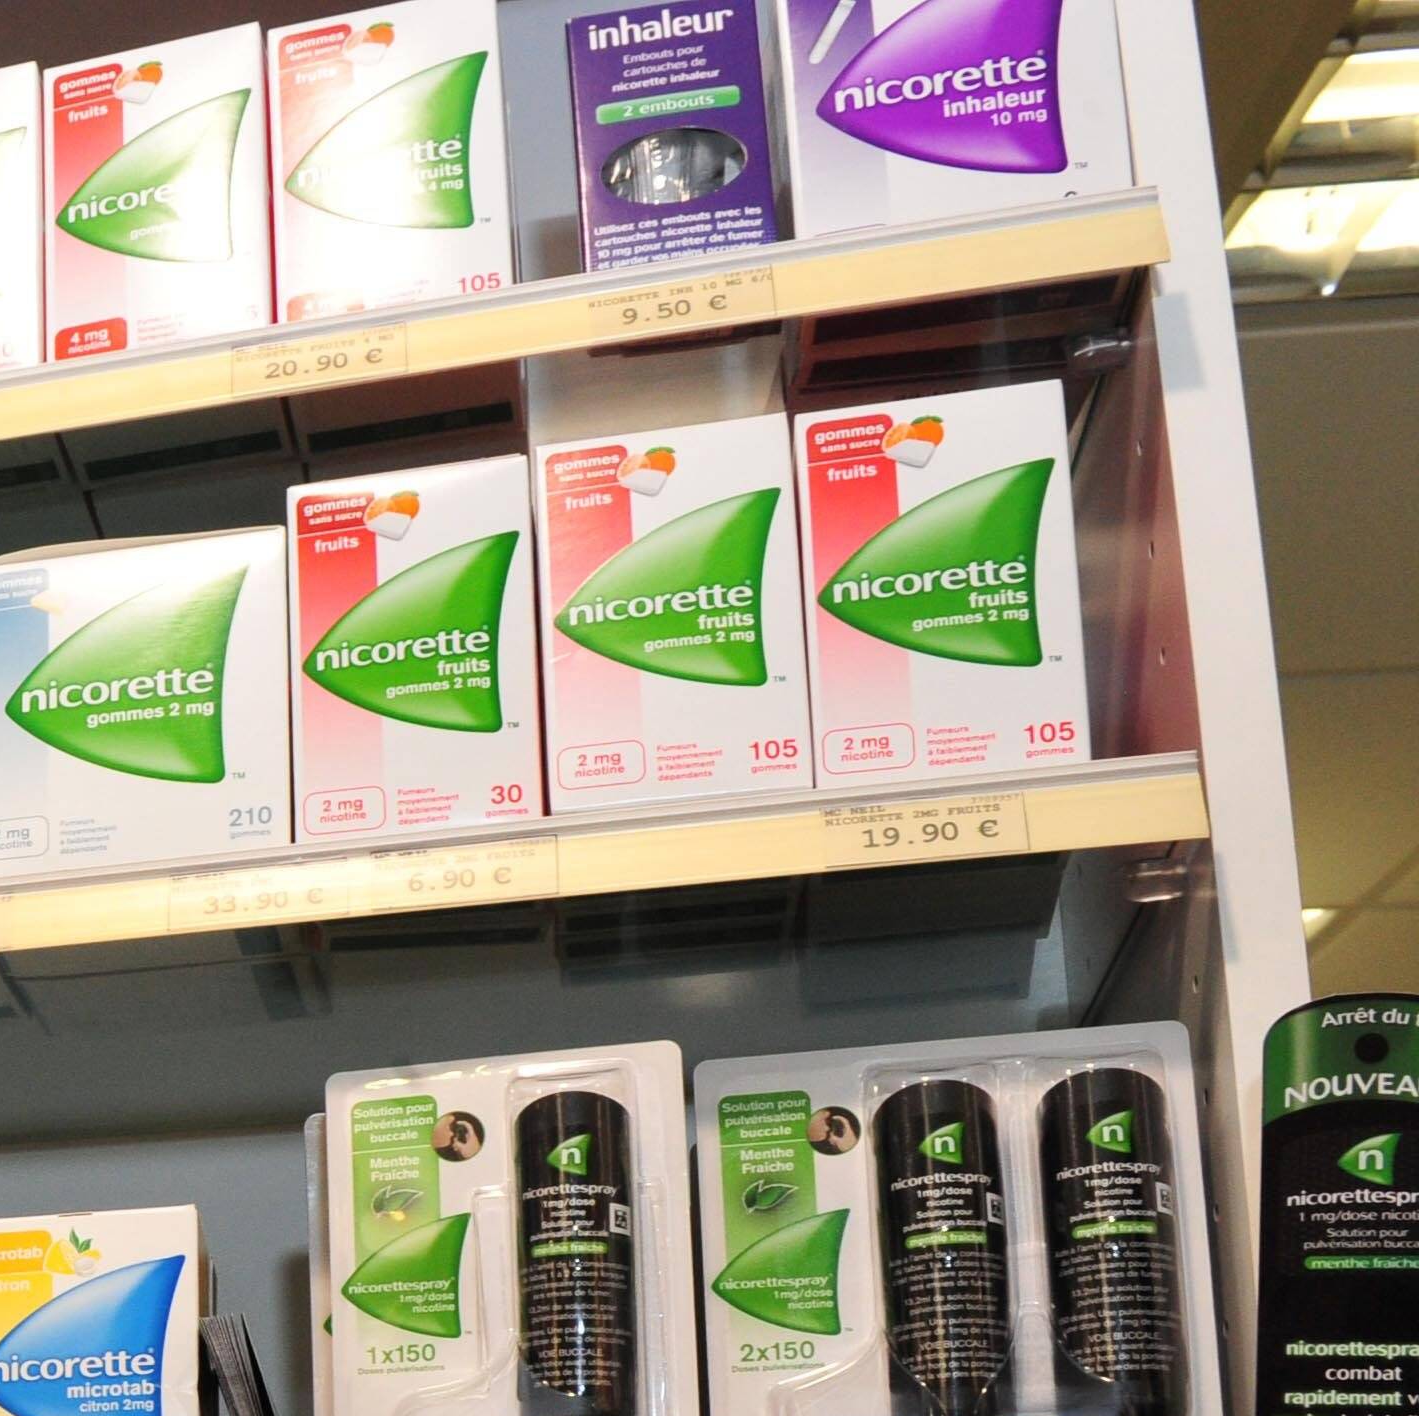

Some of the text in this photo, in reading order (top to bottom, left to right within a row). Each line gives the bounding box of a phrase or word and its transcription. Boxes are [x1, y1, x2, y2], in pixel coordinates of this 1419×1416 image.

[588, 7, 733, 50] inhaleur
[834, 53, 1047, 113] nicorette
[623, 94, 714, 117] 2 embouts
[943, 87, 1046, 118] inhaleur
[990, 107, 1047, 126] 10 mg
[832, 559, 1027, 605] nicorette
[316, 627, 491, 671] nicorette
[21, 668, 214, 713] nicorette
[86, 699, 214, 729] gommes 2 mg
[1023, 721, 1075, 746] 105
[229, 804, 273, 829] 210
[825, 804, 1001, 827] NICORETTE 2MG FRUITS
[861, 818, 998, 849] 19.90 €
[349, 1278, 451, 1297] nicorettespray
[366, 1343, 435, 1364] 1x150
[740, 1340, 815, 1363] 2x150
[1325, 1364, 1402, 1383] combat
[67, 1380, 154, 1398] microtab
[1284, 1387, 1401, 1409] rapidement
[79, 1399, 154, 1414] citron 2mg
